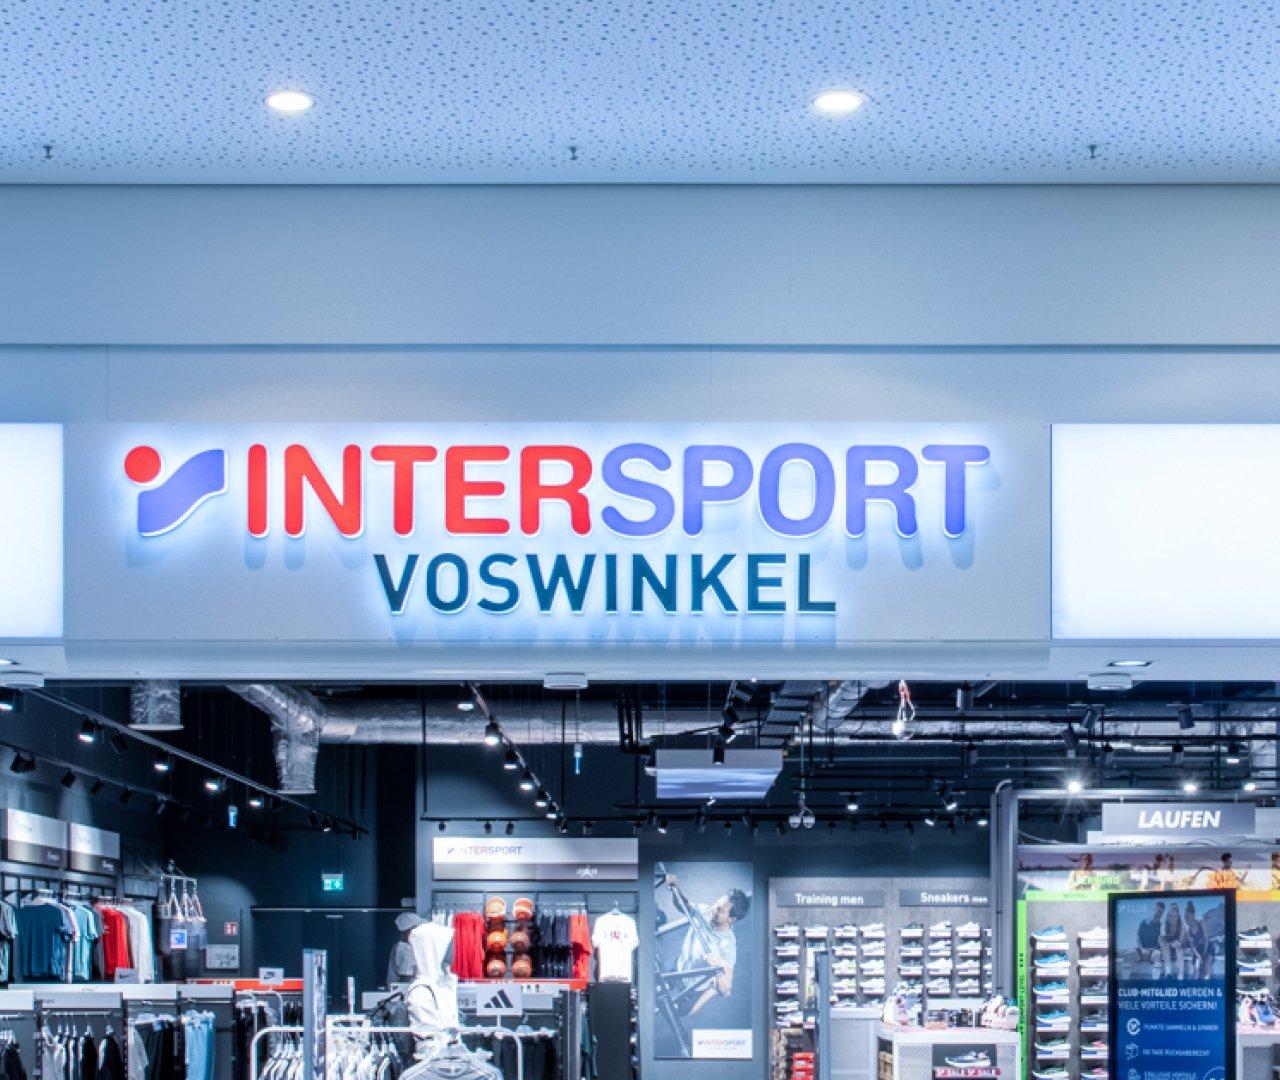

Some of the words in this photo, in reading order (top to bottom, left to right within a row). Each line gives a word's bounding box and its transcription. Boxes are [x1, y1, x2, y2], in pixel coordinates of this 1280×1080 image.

[247, 442, 991, 539] INTERSPORT
[373, 552, 836, 614] VOSWINKEL
[1138, 809, 1221, 829] LAUFEN
[460, 846, 523, 856] TERSPORT
[795, 892, 838, 907] Training
[840, 895, 864, 905] men
[920, 892, 969, 904] Sneakers
